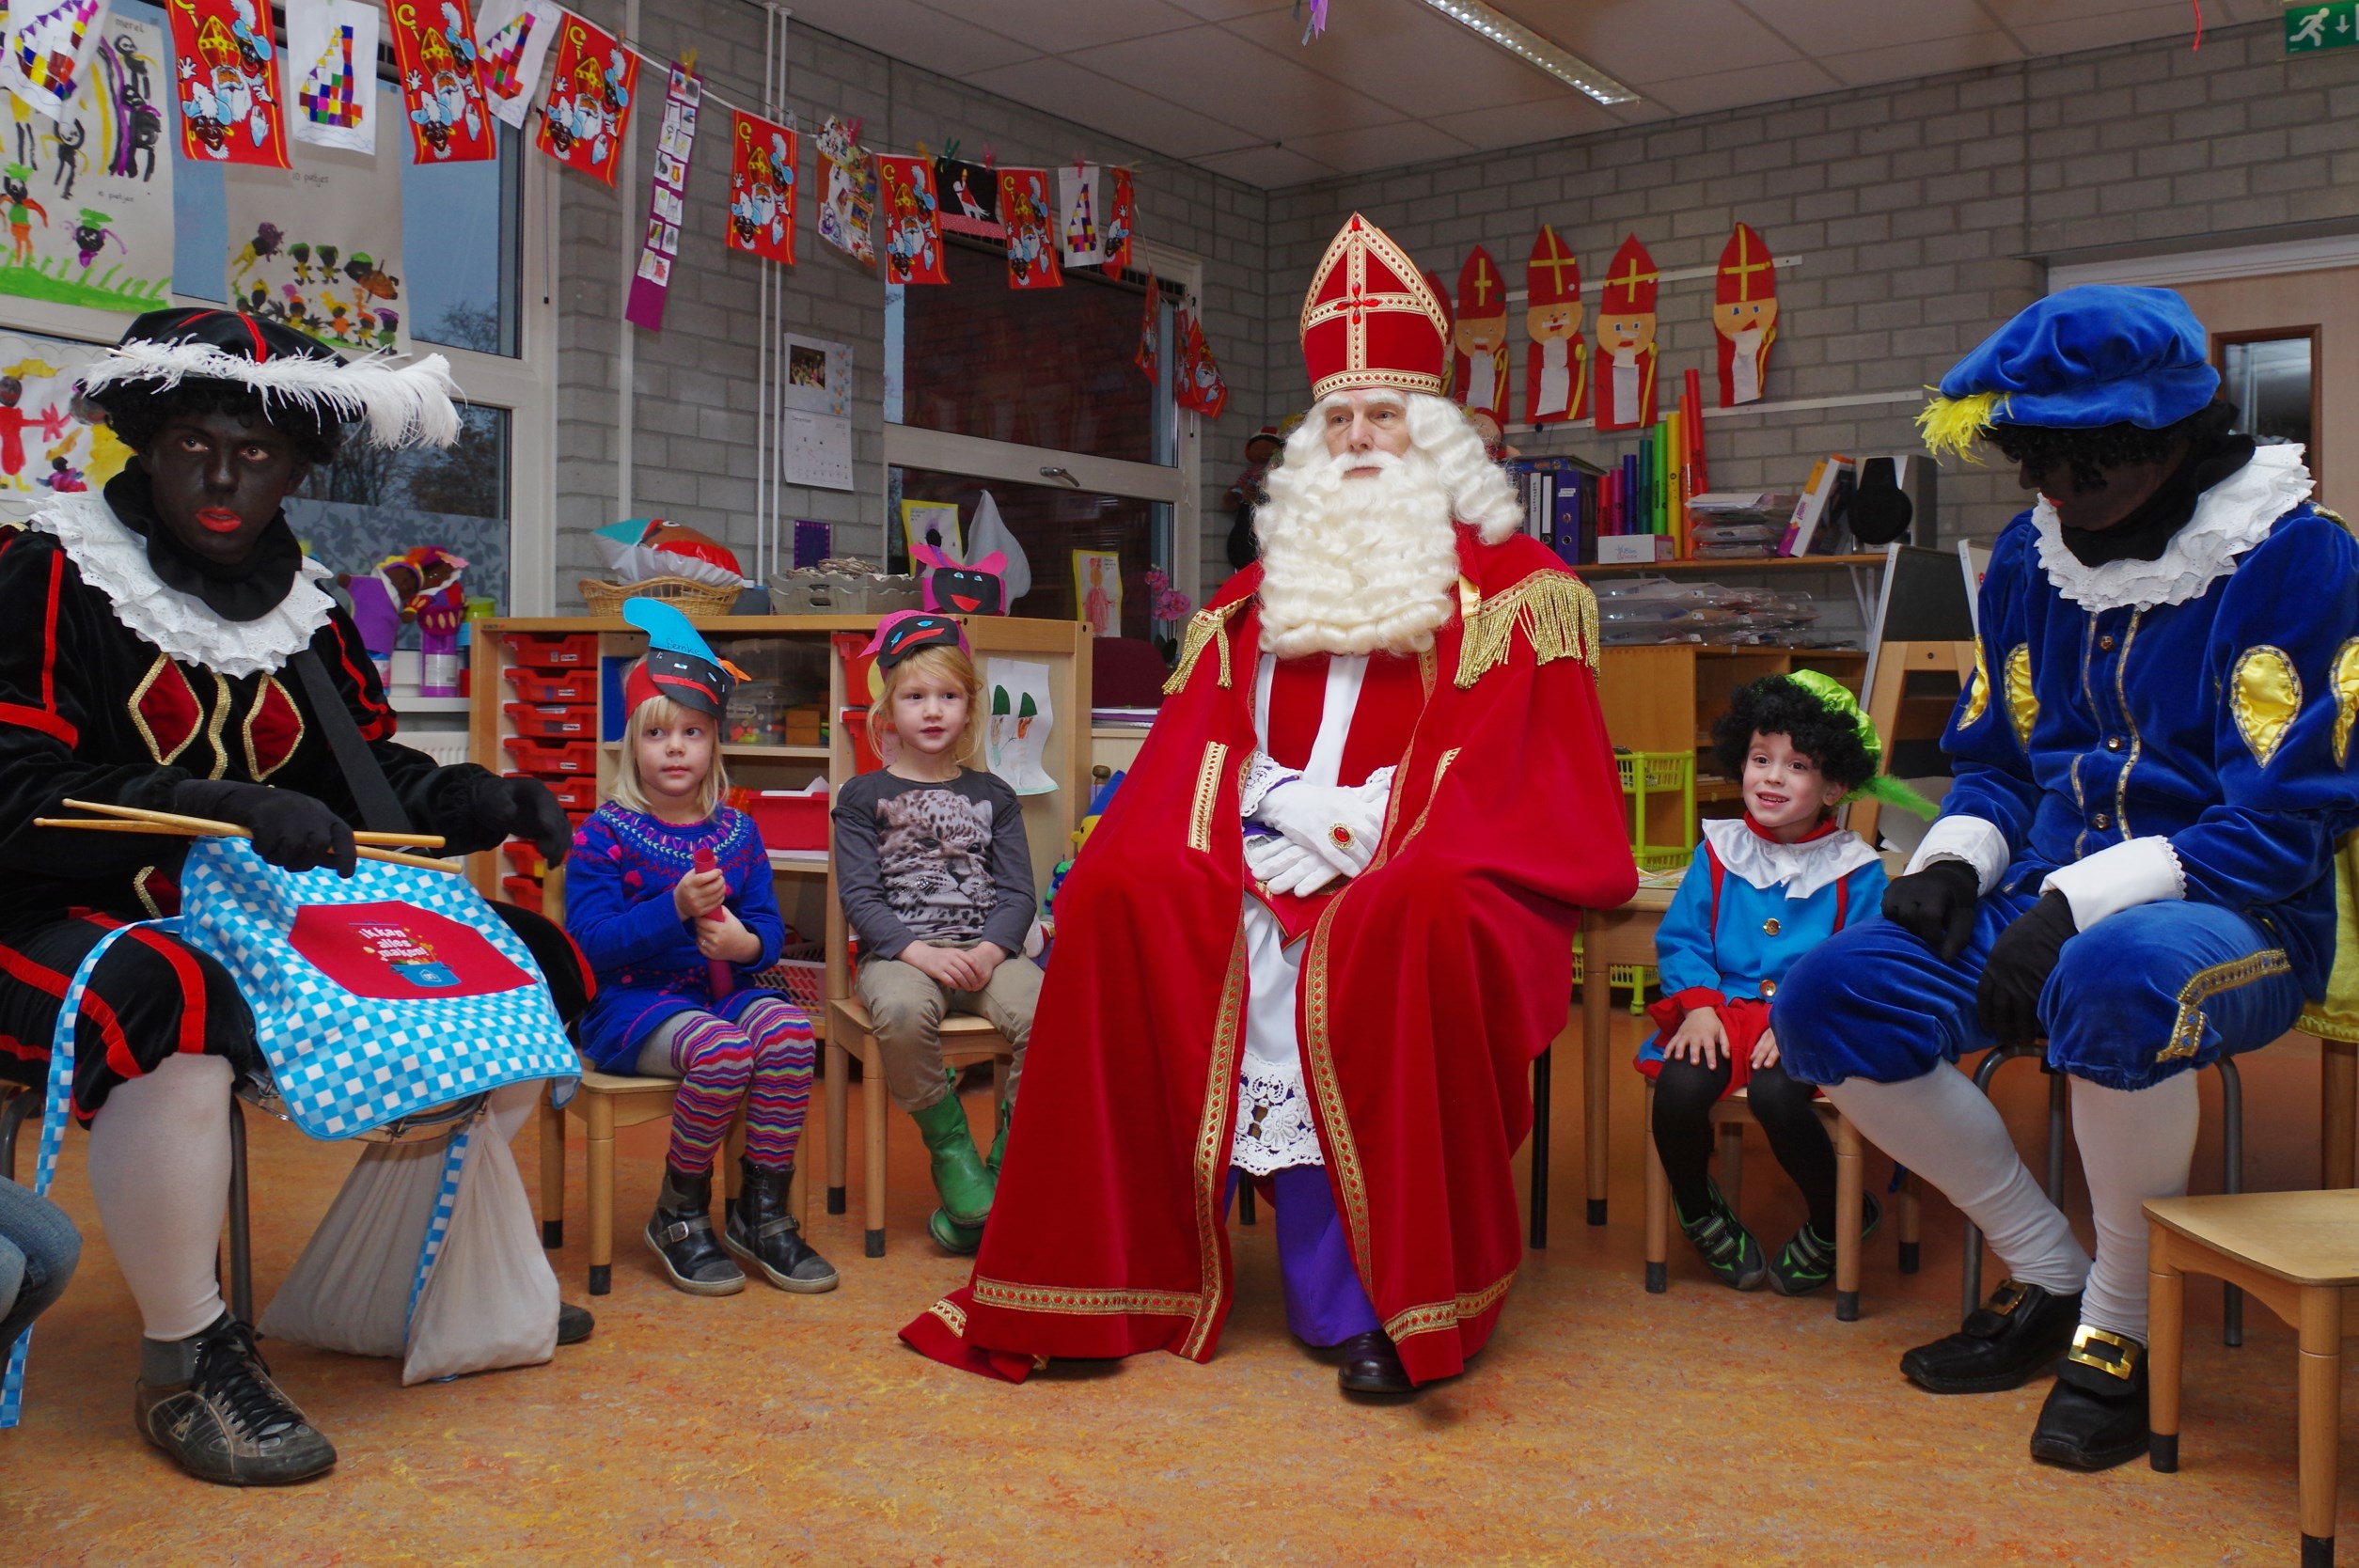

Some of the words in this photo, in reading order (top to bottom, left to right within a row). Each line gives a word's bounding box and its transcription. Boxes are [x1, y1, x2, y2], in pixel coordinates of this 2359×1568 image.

[115, 18, 145, 33] merel
[304, 172, 329, 188] pietjes
[373, 927, 406, 937] kan
[377, 938, 412, 949] alles
[377, 947, 430, 957] maken!
